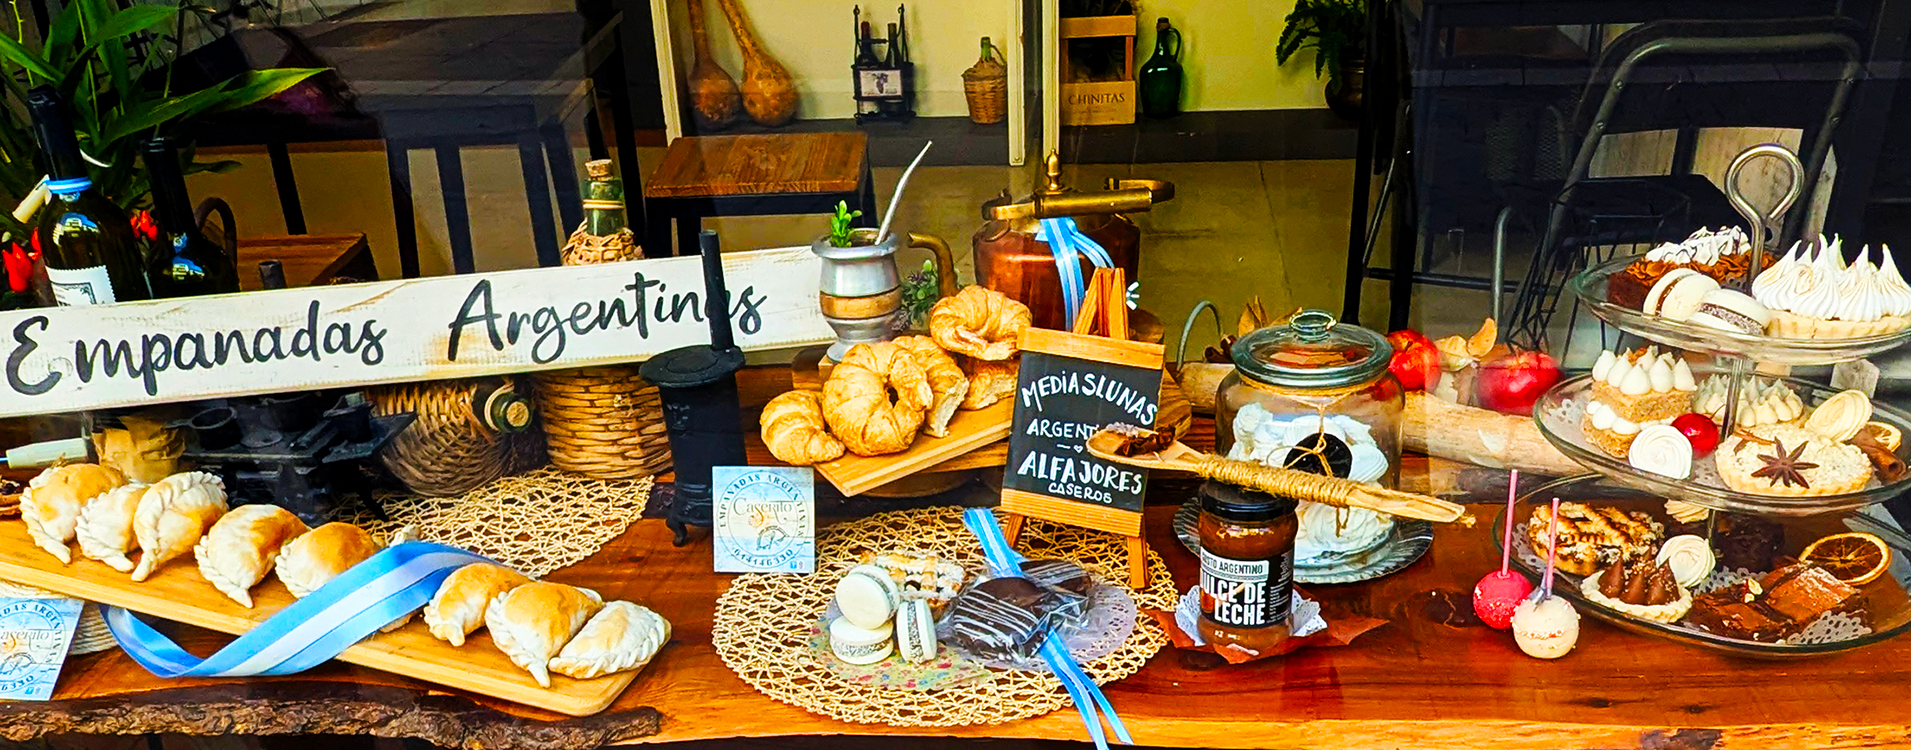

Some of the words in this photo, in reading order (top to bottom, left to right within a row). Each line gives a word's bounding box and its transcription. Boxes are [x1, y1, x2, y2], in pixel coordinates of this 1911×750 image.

[1068, 93, 1125, 105] CHINITAS
[6, 299, 388, 396] Empanadas
[1017, 450, 1143, 495] ALFAJORES
[1048, 481, 1112, 504] CASEROS
[1219, 561, 1263, 575] ARGENTINO
[1244, 582, 1267, 605] DE
[1214, 599, 1266, 626] LECHE
